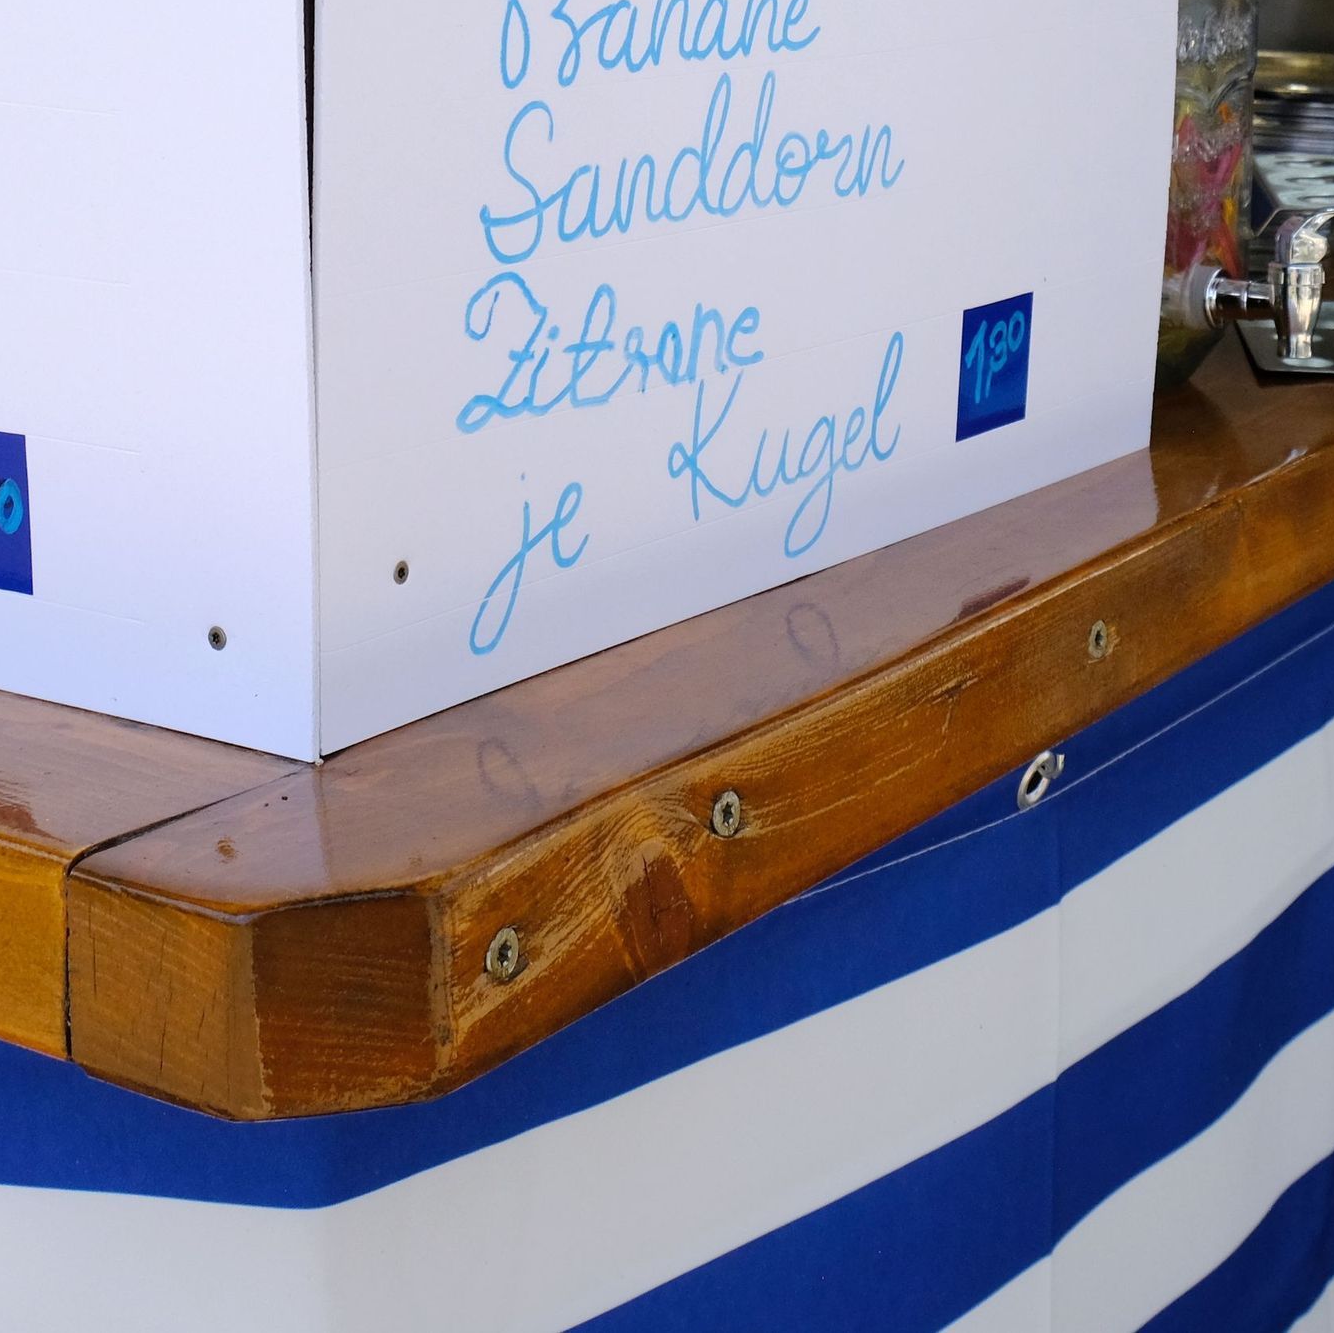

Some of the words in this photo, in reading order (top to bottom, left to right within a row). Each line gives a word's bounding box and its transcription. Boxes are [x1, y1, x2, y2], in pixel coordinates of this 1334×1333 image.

[479, 71, 905, 265] Sanddorn
[455, 270, 765, 435] Zitrone
[469, 473, 590, 656] je
[668, 331, 905, 559] Kugel
